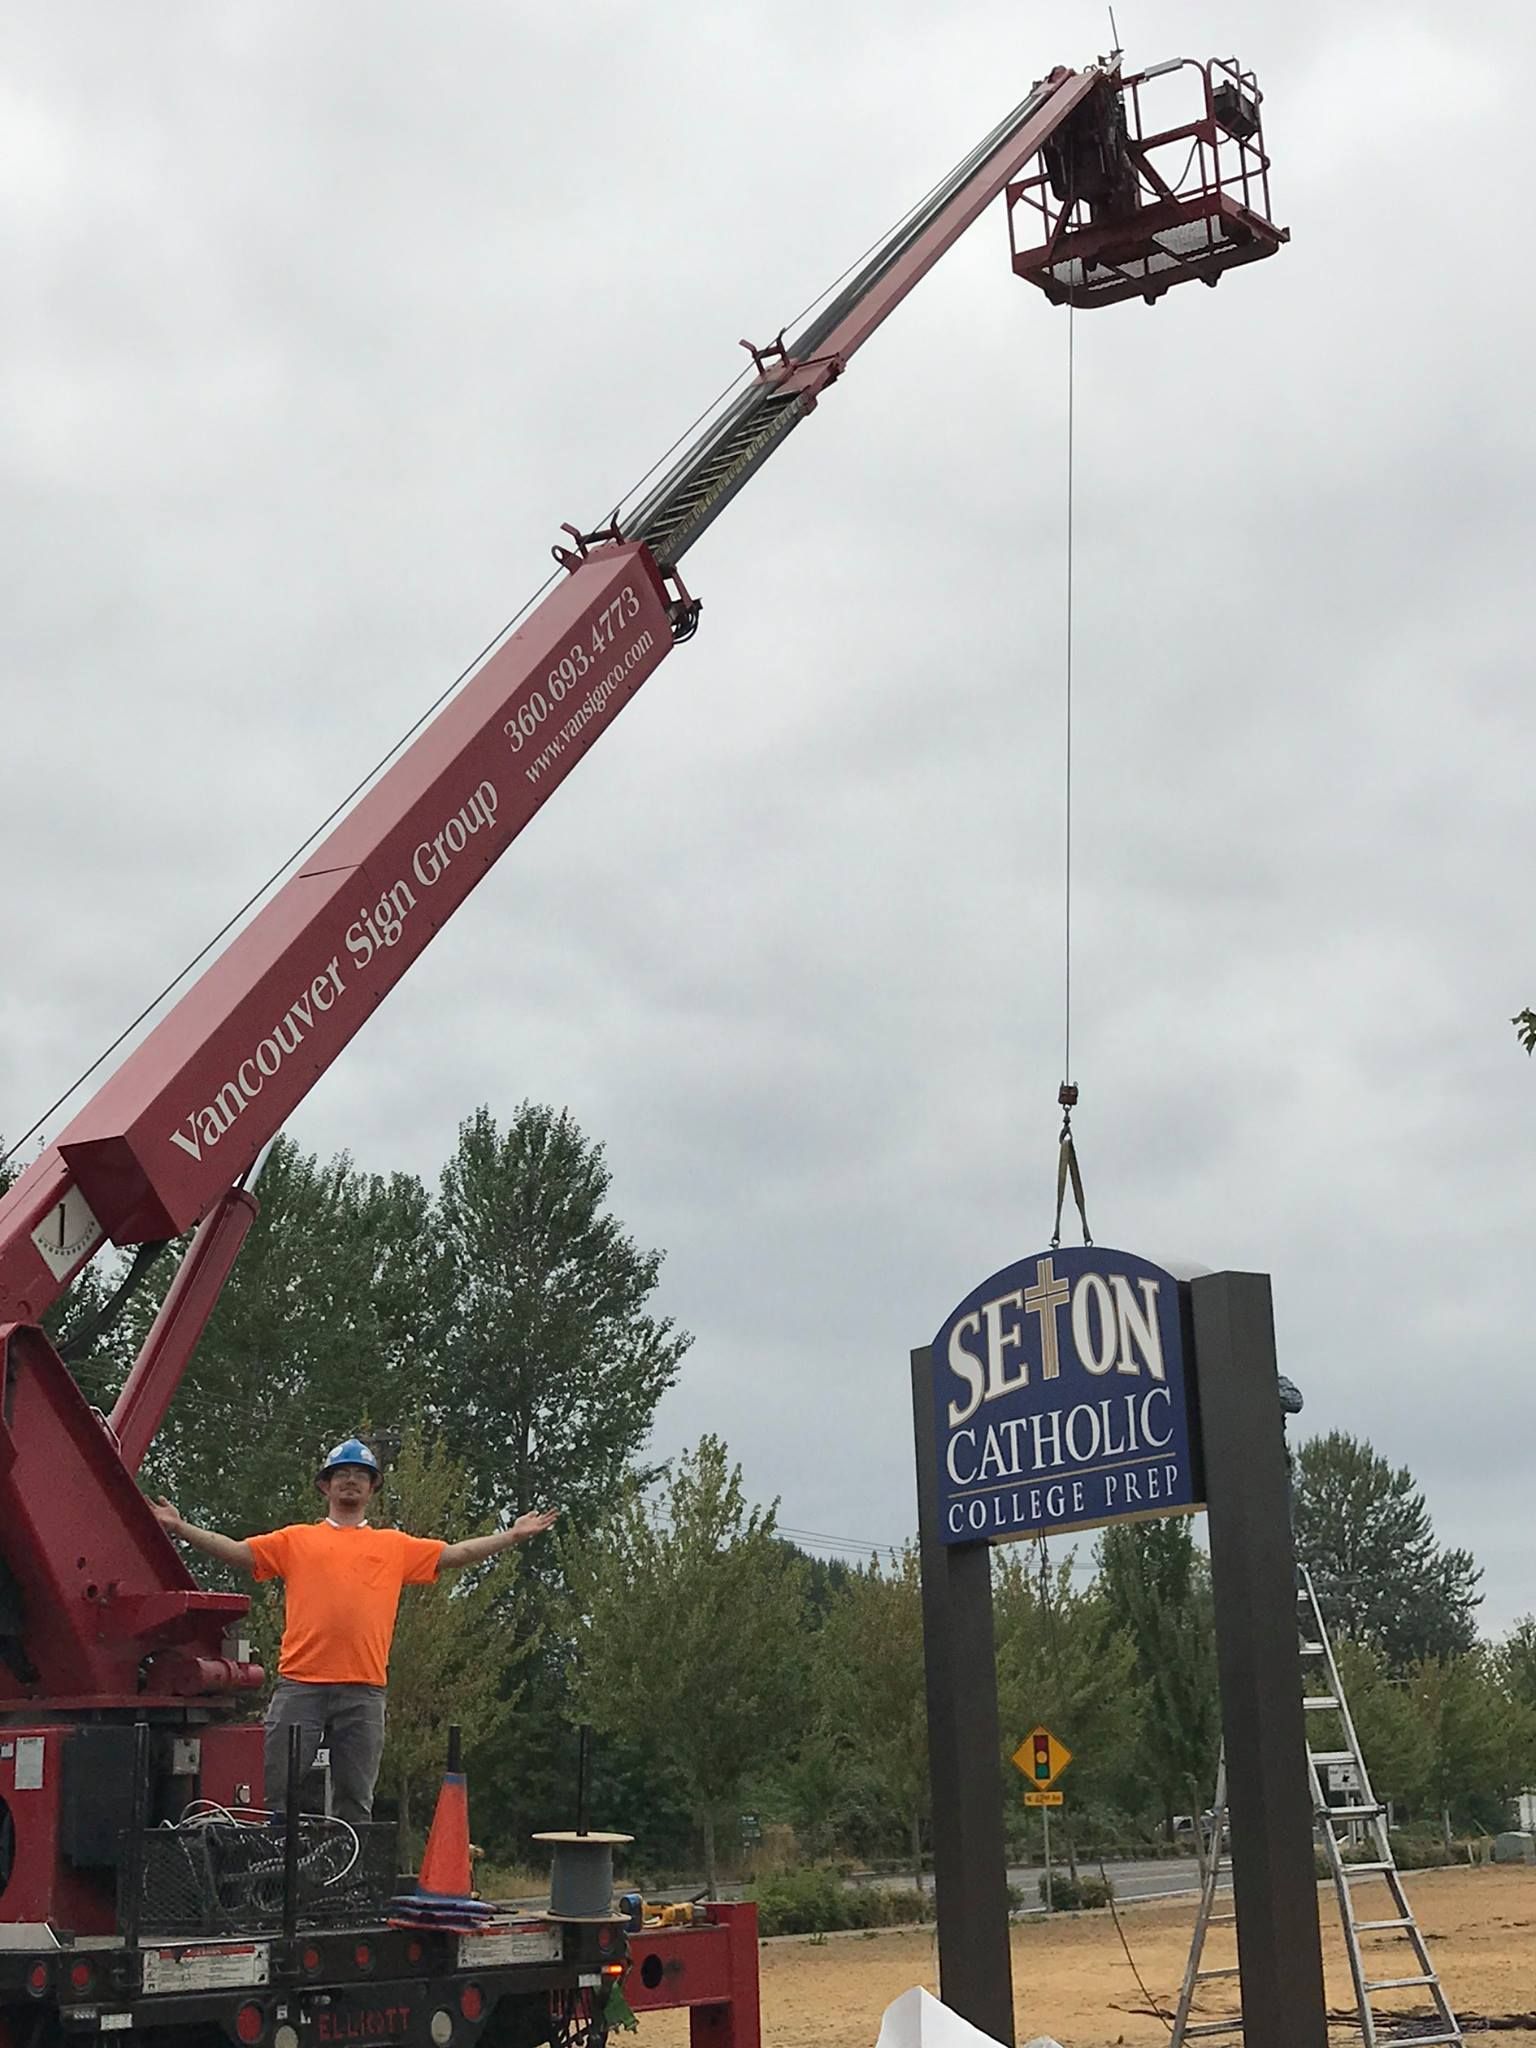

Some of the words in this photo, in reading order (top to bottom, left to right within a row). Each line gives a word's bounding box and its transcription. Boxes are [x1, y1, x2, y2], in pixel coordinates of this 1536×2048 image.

[503, 586, 640, 753] 360.693.4773
[525, 630, 654, 784] www.vansignco.com
[169, 956, 347, 1162] Vancouver
[345, 879, 417, 969] Sign
[412, 780, 498, 887] Group
[948, 1257, 1166, 1428] SETON
[946, 1386, 1174, 1485] CATHOLIC
[948, 1482, 1084, 1534] COLLEGE
[1105, 1464, 1178, 1507] PREP
[319, 2008, 411, 2041] ELLIOTT
